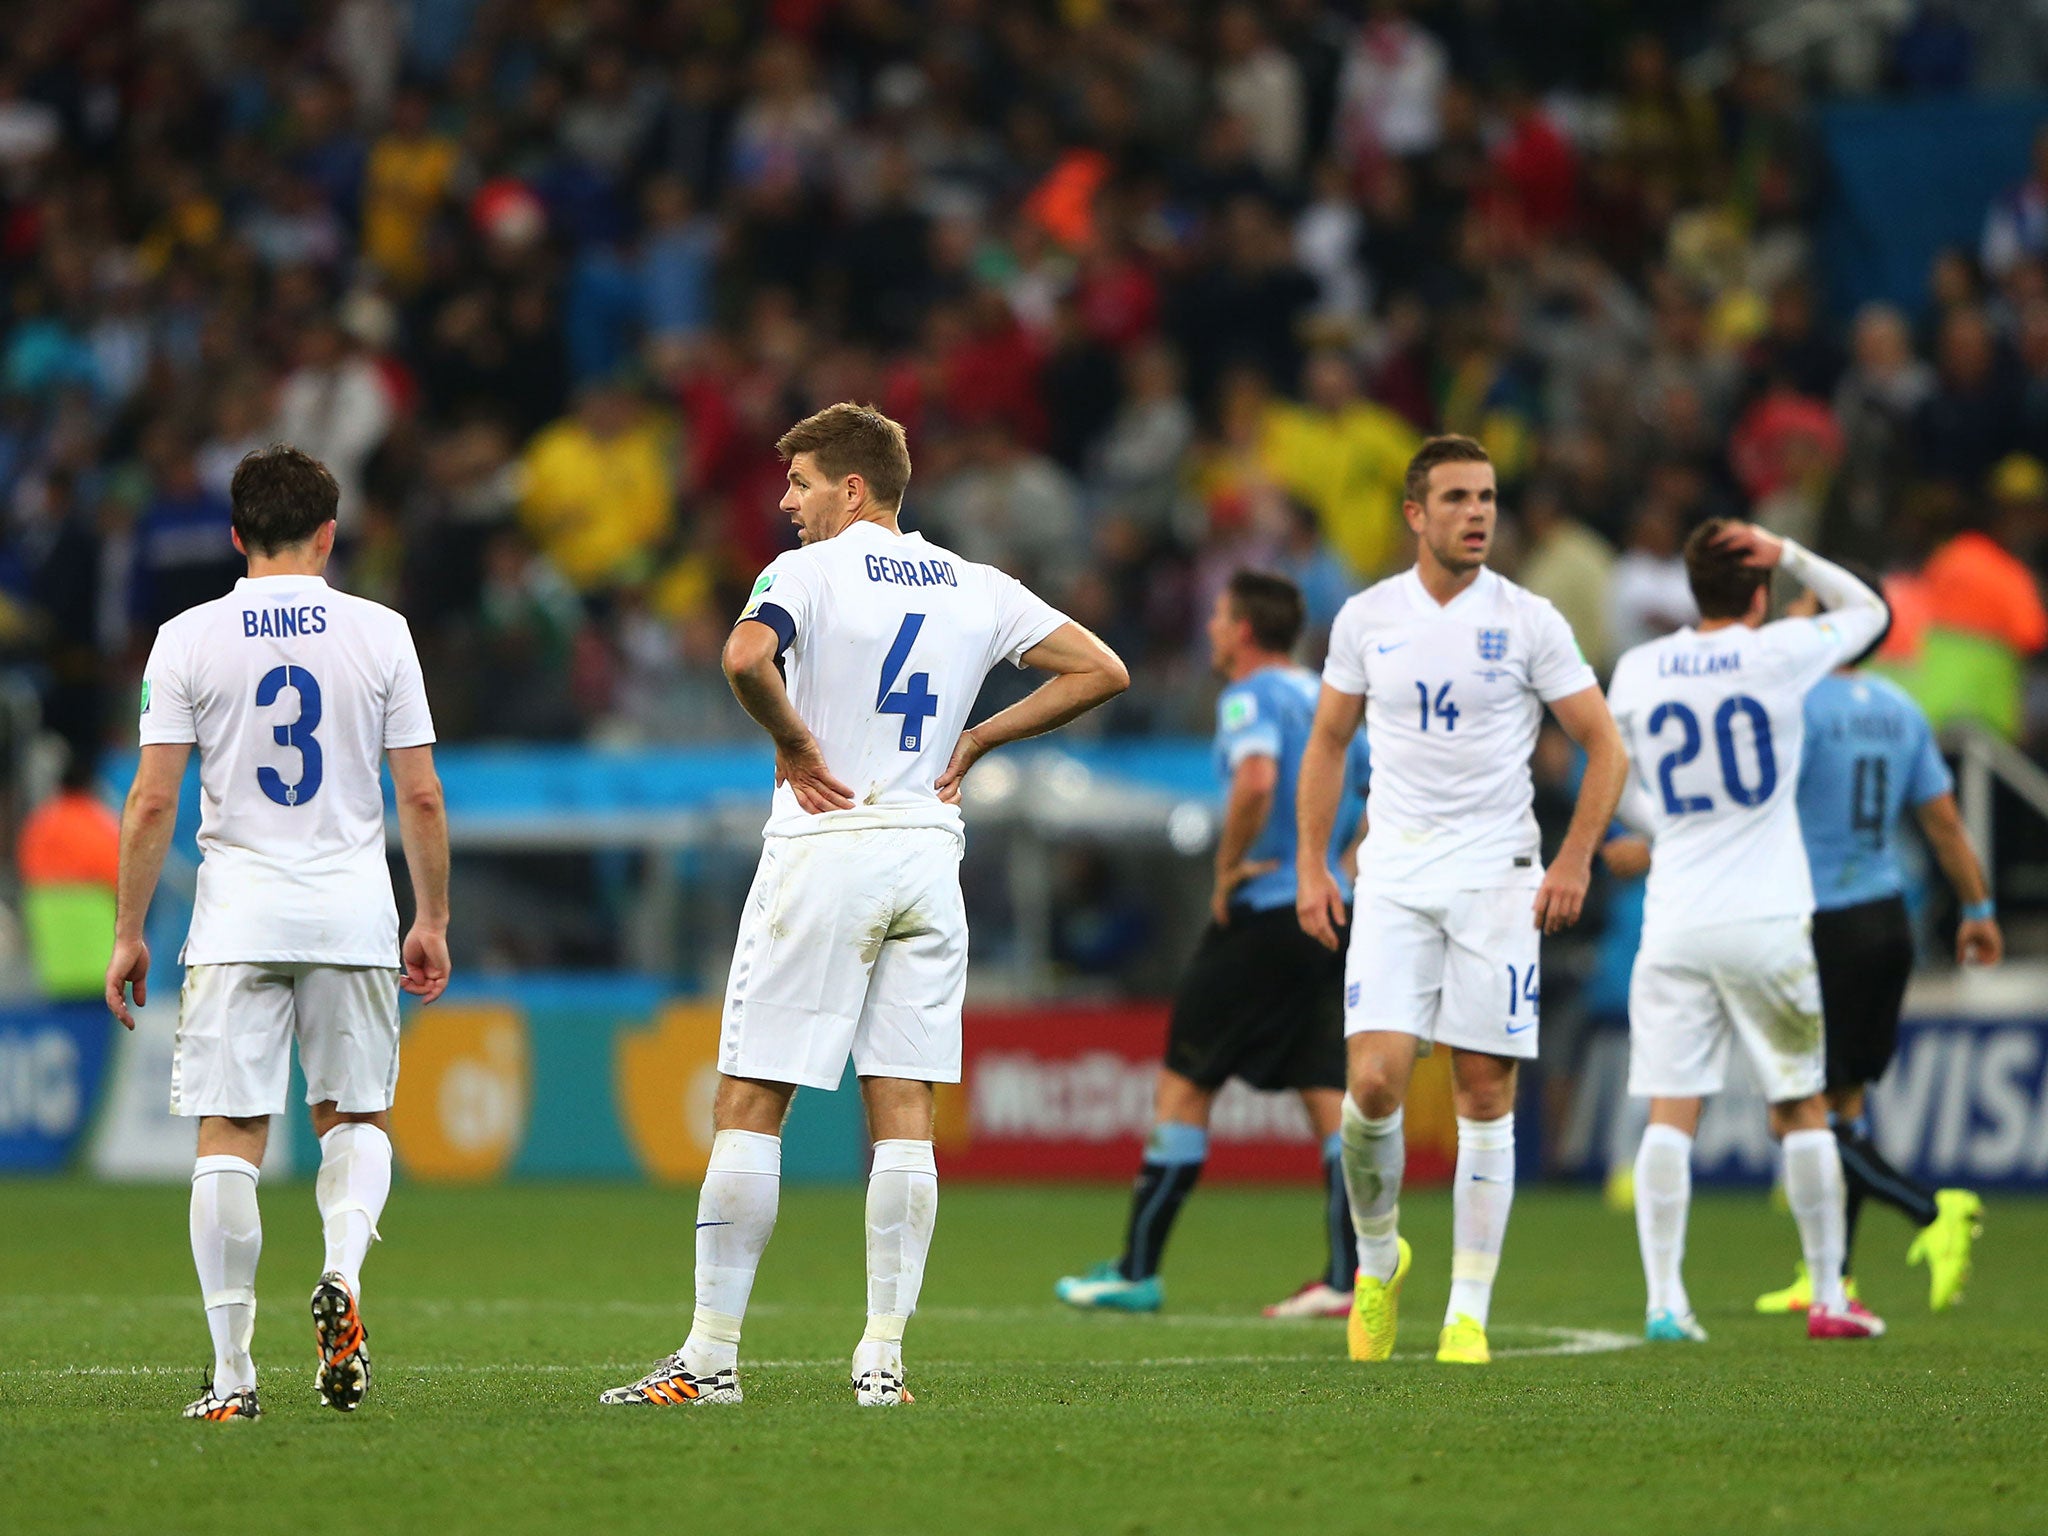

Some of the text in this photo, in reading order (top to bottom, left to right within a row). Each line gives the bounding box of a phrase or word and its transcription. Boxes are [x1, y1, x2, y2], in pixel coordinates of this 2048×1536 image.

[865, 554, 958, 588] GERRARD
[242, 605, 327, 638] BAINES
[876, 612, 939, 753] 4
[1415, 680, 1460, 732] 14
[255, 664, 323, 807] 3
[1647, 695, 1778, 816] 20
[1507, 963, 1540, 1016] 14
[1864, 1028, 2048, 1176] VIS
